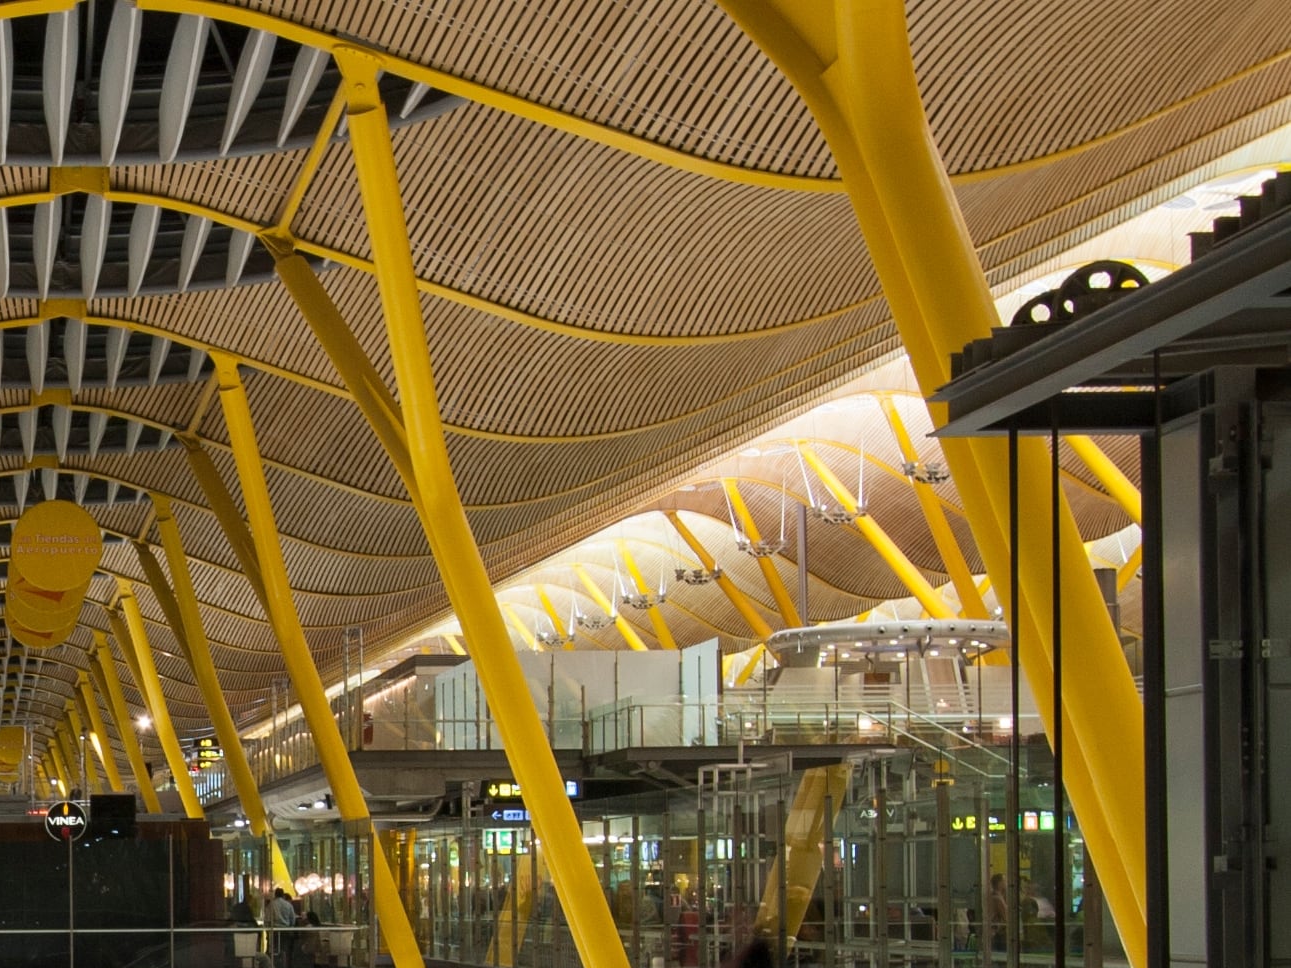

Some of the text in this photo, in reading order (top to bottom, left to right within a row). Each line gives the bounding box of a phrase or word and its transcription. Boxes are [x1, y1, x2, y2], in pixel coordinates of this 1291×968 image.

[35, 532, 79, 544] Tiendas
[17, 545, 98, 554] Aeropuerto
[47, 816, 85, 826] VINEA
